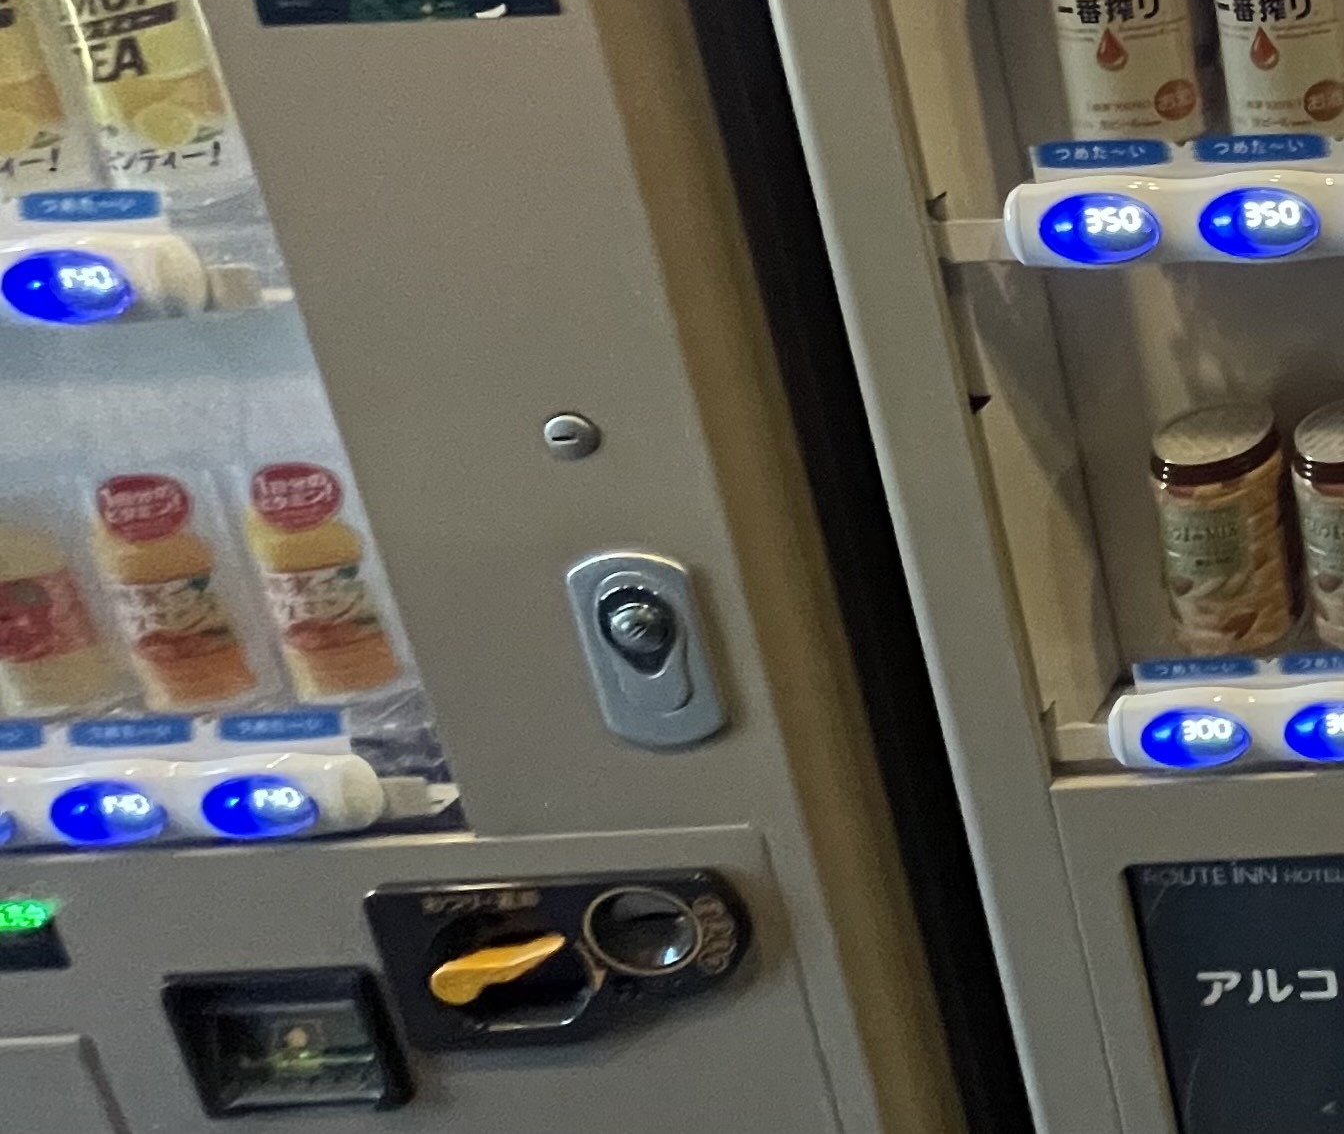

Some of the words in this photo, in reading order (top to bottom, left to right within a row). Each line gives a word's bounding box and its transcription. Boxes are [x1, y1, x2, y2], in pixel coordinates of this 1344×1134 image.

[1085, 205, 1144, 233] 350
[1245, 200, 1301, 227] 350
[1183, 718, 1232, 741] 300
